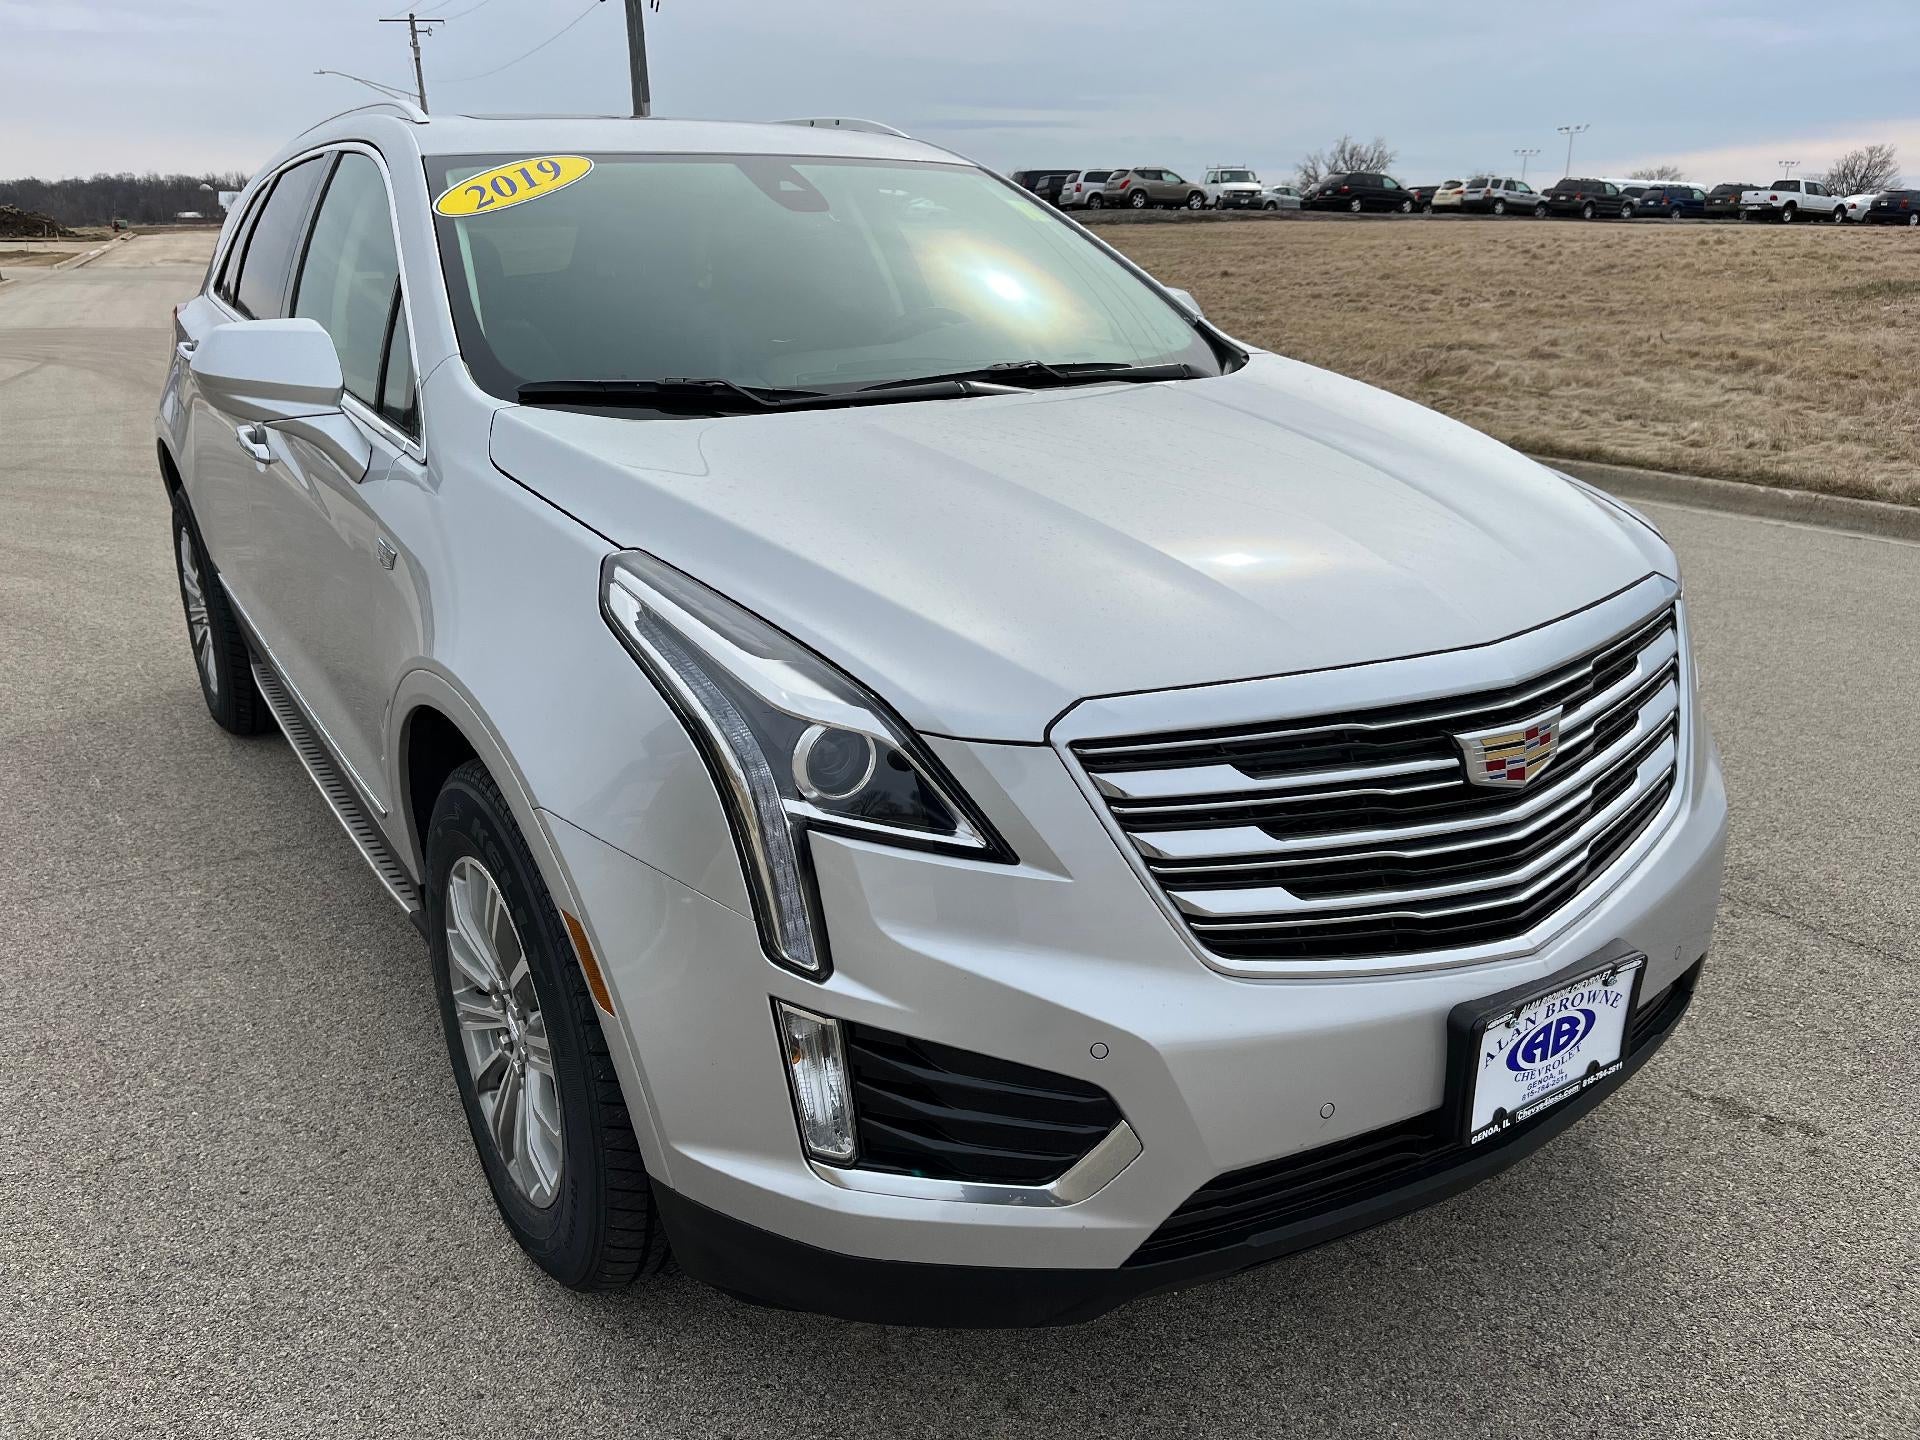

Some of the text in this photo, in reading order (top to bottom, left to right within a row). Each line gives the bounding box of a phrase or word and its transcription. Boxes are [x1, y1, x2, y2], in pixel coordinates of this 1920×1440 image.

[464, 159, 562, 210] 2019
[1484, 989, 1623, 1069] ALAN BROWNE
[1521, 1015, 1581, 1064] AB
[1514, 1043, 1582, 1083] CHEVROLET
[1527, 1073, 1556, 1091] GENOA,
[1471, 1124, 1501, 1145] GENOA,
[1502, 1118, 1511, 1128] IL
